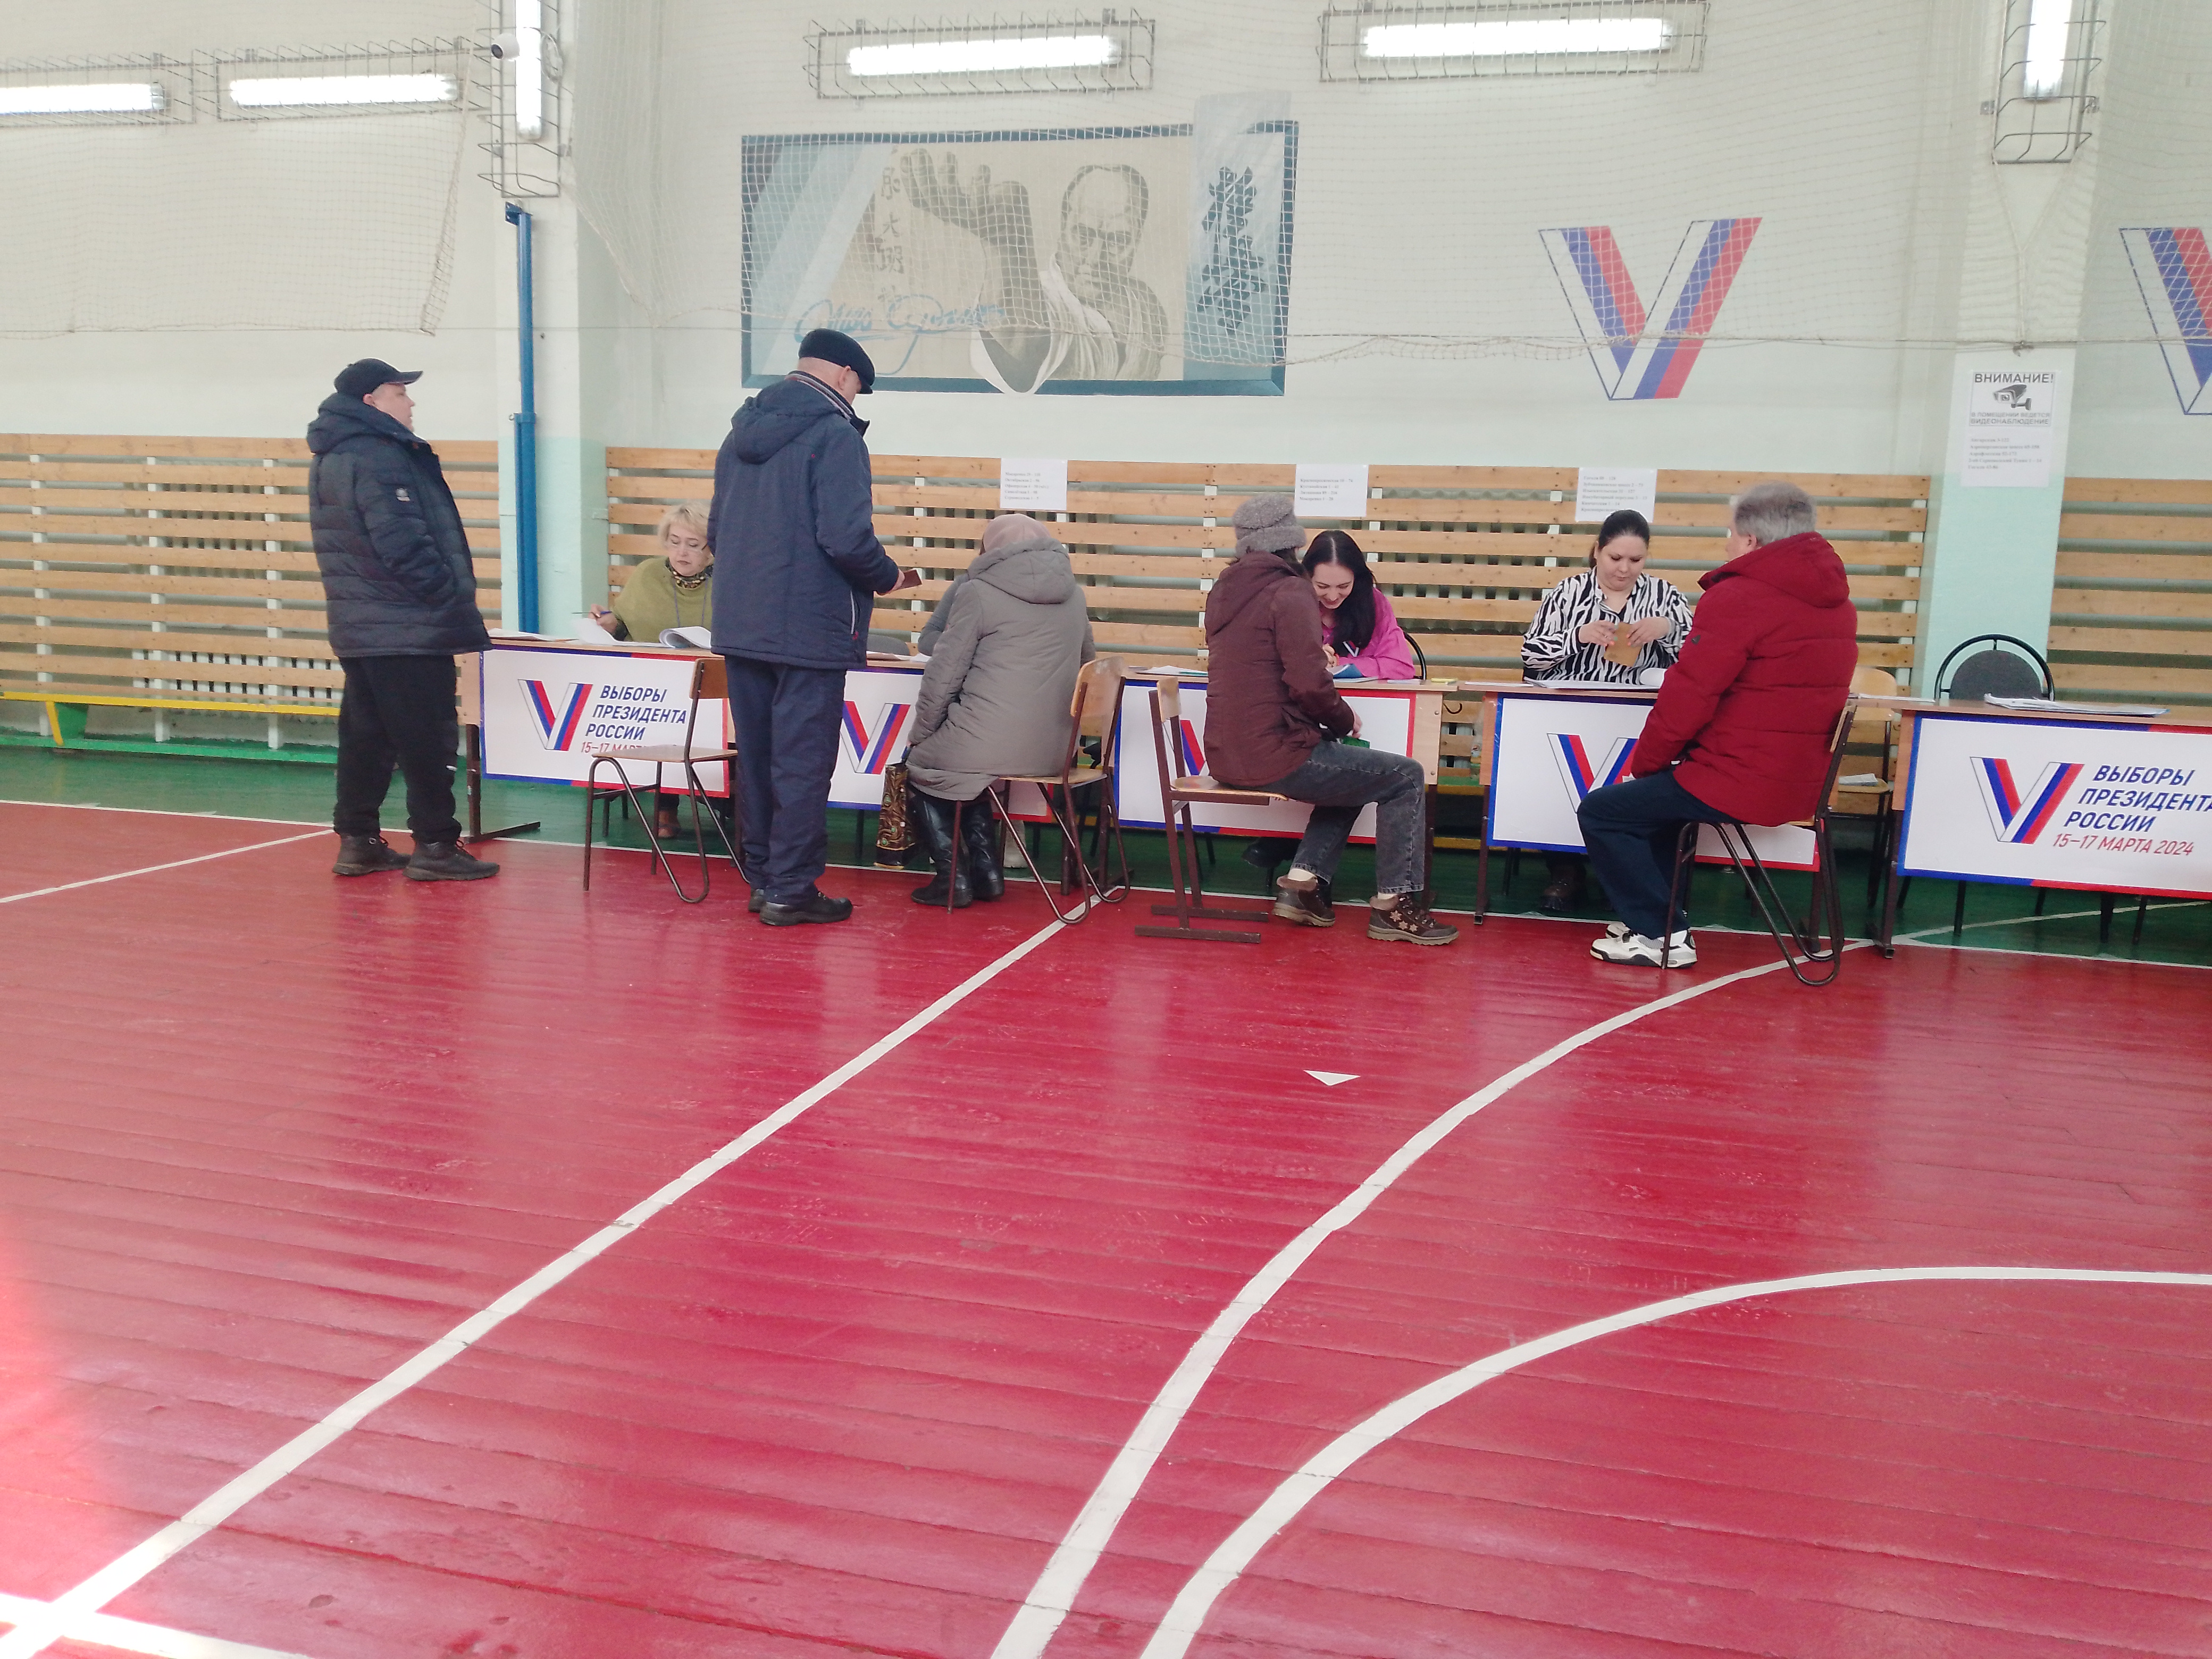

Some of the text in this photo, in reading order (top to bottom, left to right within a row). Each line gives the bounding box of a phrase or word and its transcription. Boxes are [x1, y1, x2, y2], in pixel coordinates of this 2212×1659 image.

[1974, 373, 2053, 383] ВНИМАНИЕ!
[599, 685, 668, 703] ВЫБОРЫ
[592, 704, 687, 724] ПРЕЗИДЕНТА
[585, 723, 646, 741] РОССИИ
[2092, 764, 2196, 786] ВЫБОРЫ
[2063, 810, 2157, 833] РОССИИ
[2097, 836, 2154, 853] МАРТА
[2153, 840, 2194, 856] 2024
